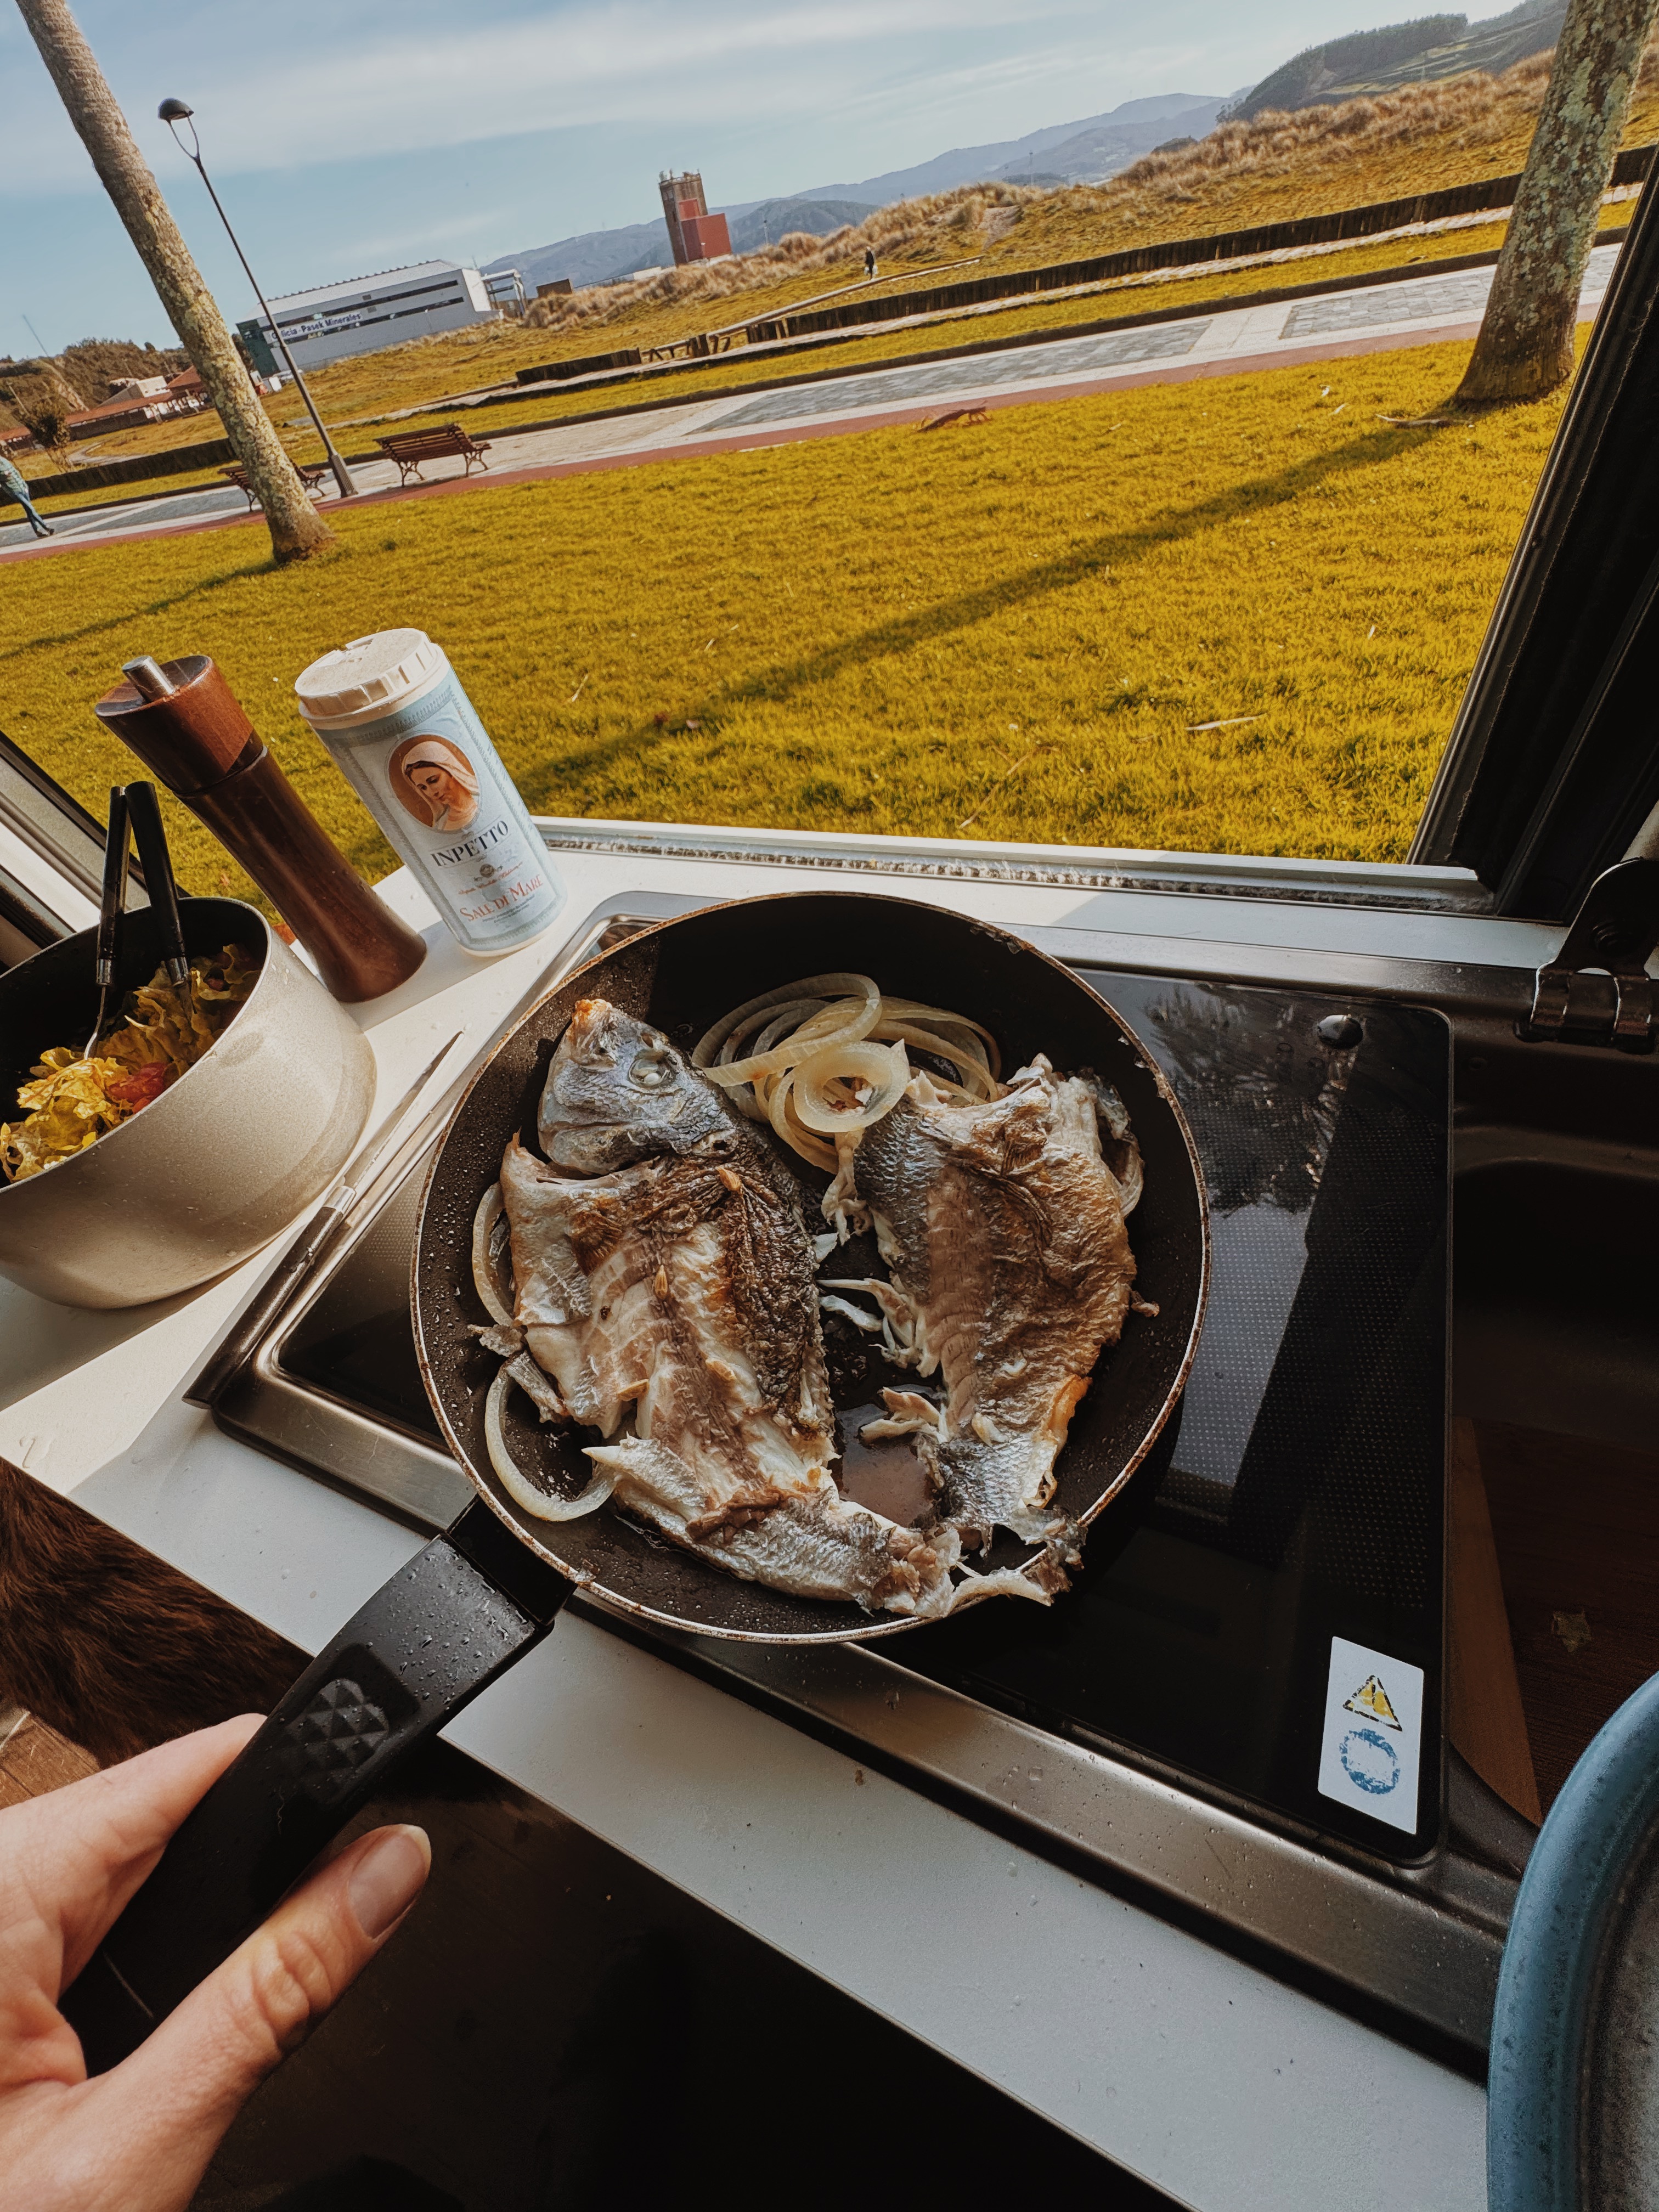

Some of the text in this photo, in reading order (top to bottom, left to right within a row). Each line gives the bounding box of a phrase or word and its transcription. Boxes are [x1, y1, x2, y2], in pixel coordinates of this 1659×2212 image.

[301, 321, 324, 332] Pasek
[325, 314, 361, 326] Minerales
[431, 820, 509, 866] INPETTO
[459, 904, 495, 922] SALE
[493, 895, 510, 910] DI
[509, 874, 543, 901] MARE
